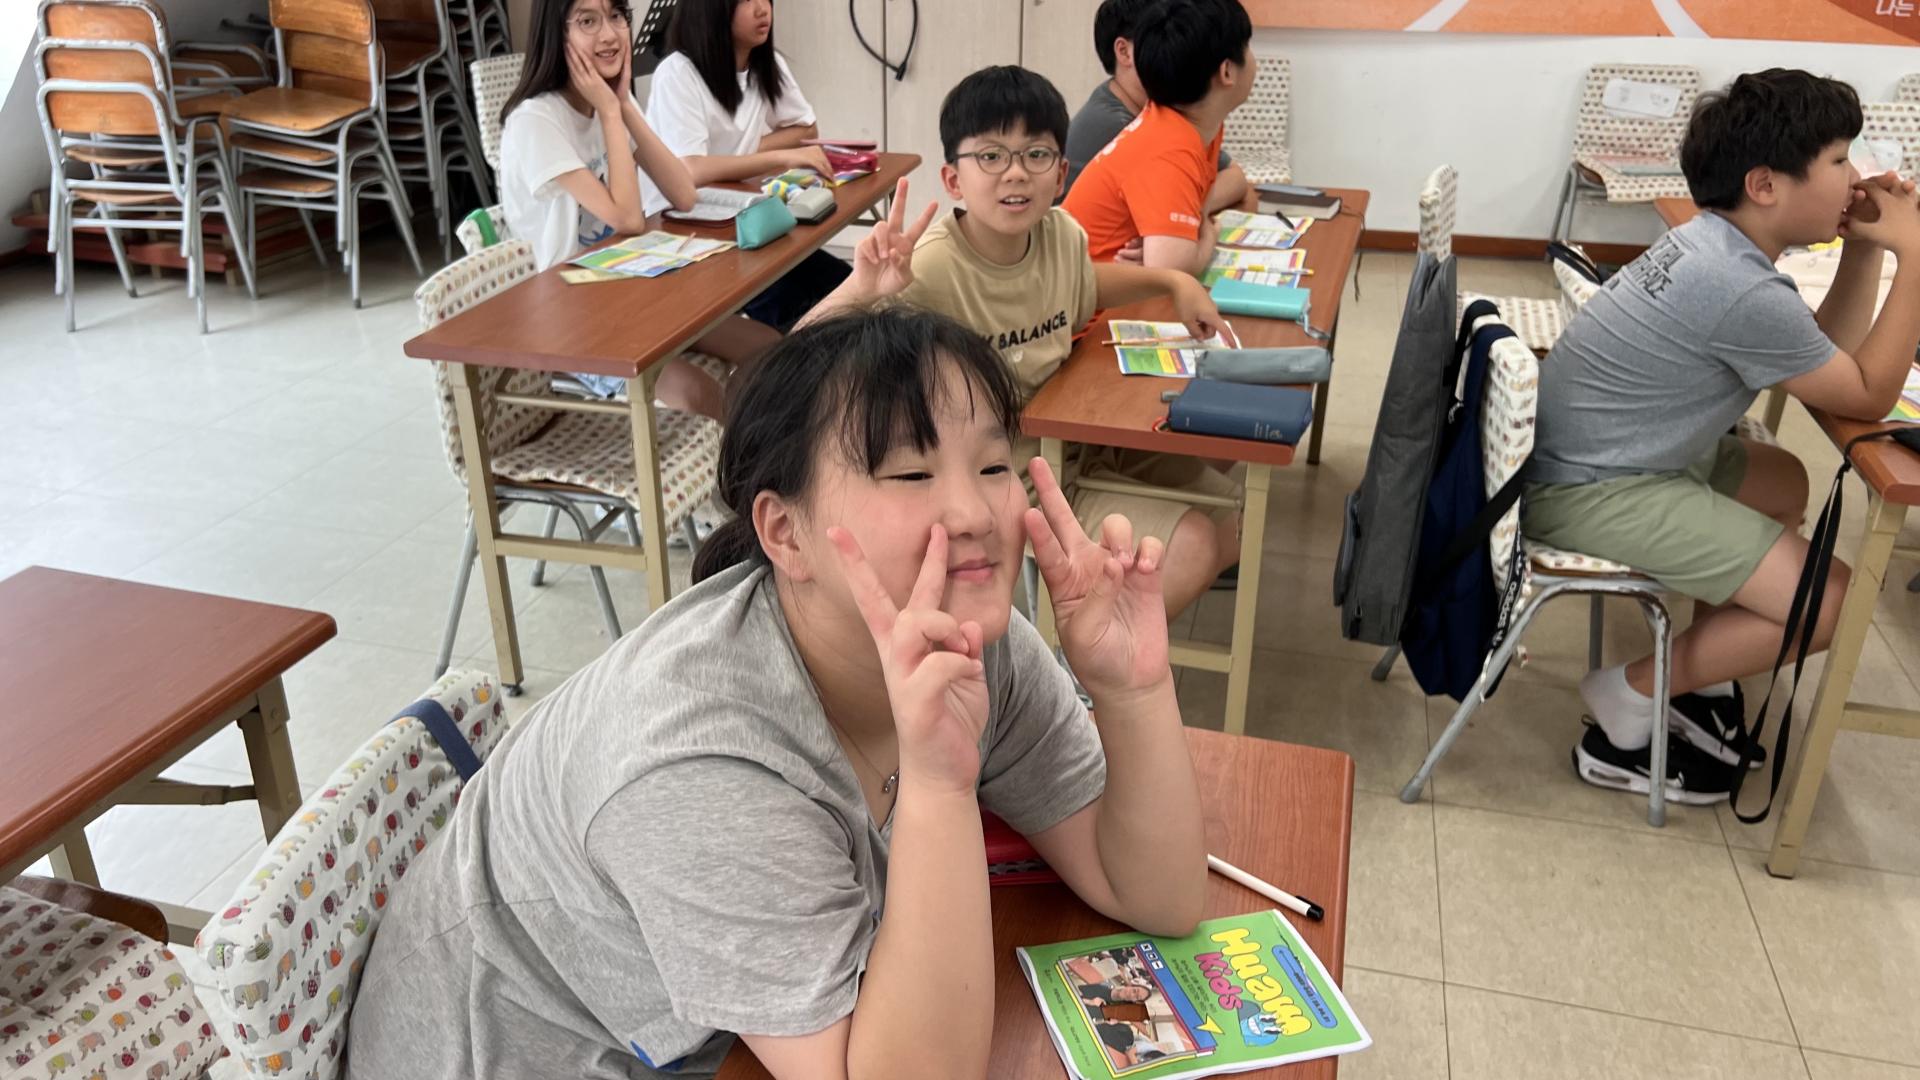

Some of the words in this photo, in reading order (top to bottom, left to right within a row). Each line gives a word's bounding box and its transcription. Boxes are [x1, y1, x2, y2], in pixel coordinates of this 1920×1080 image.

[998, 310, 1067, 350] BALANCE
[1498, 581, 1517, 629] adidas
[1194, 952, 1243, 1011] Kids
[1210, 928, 1312, 1036] Huam
